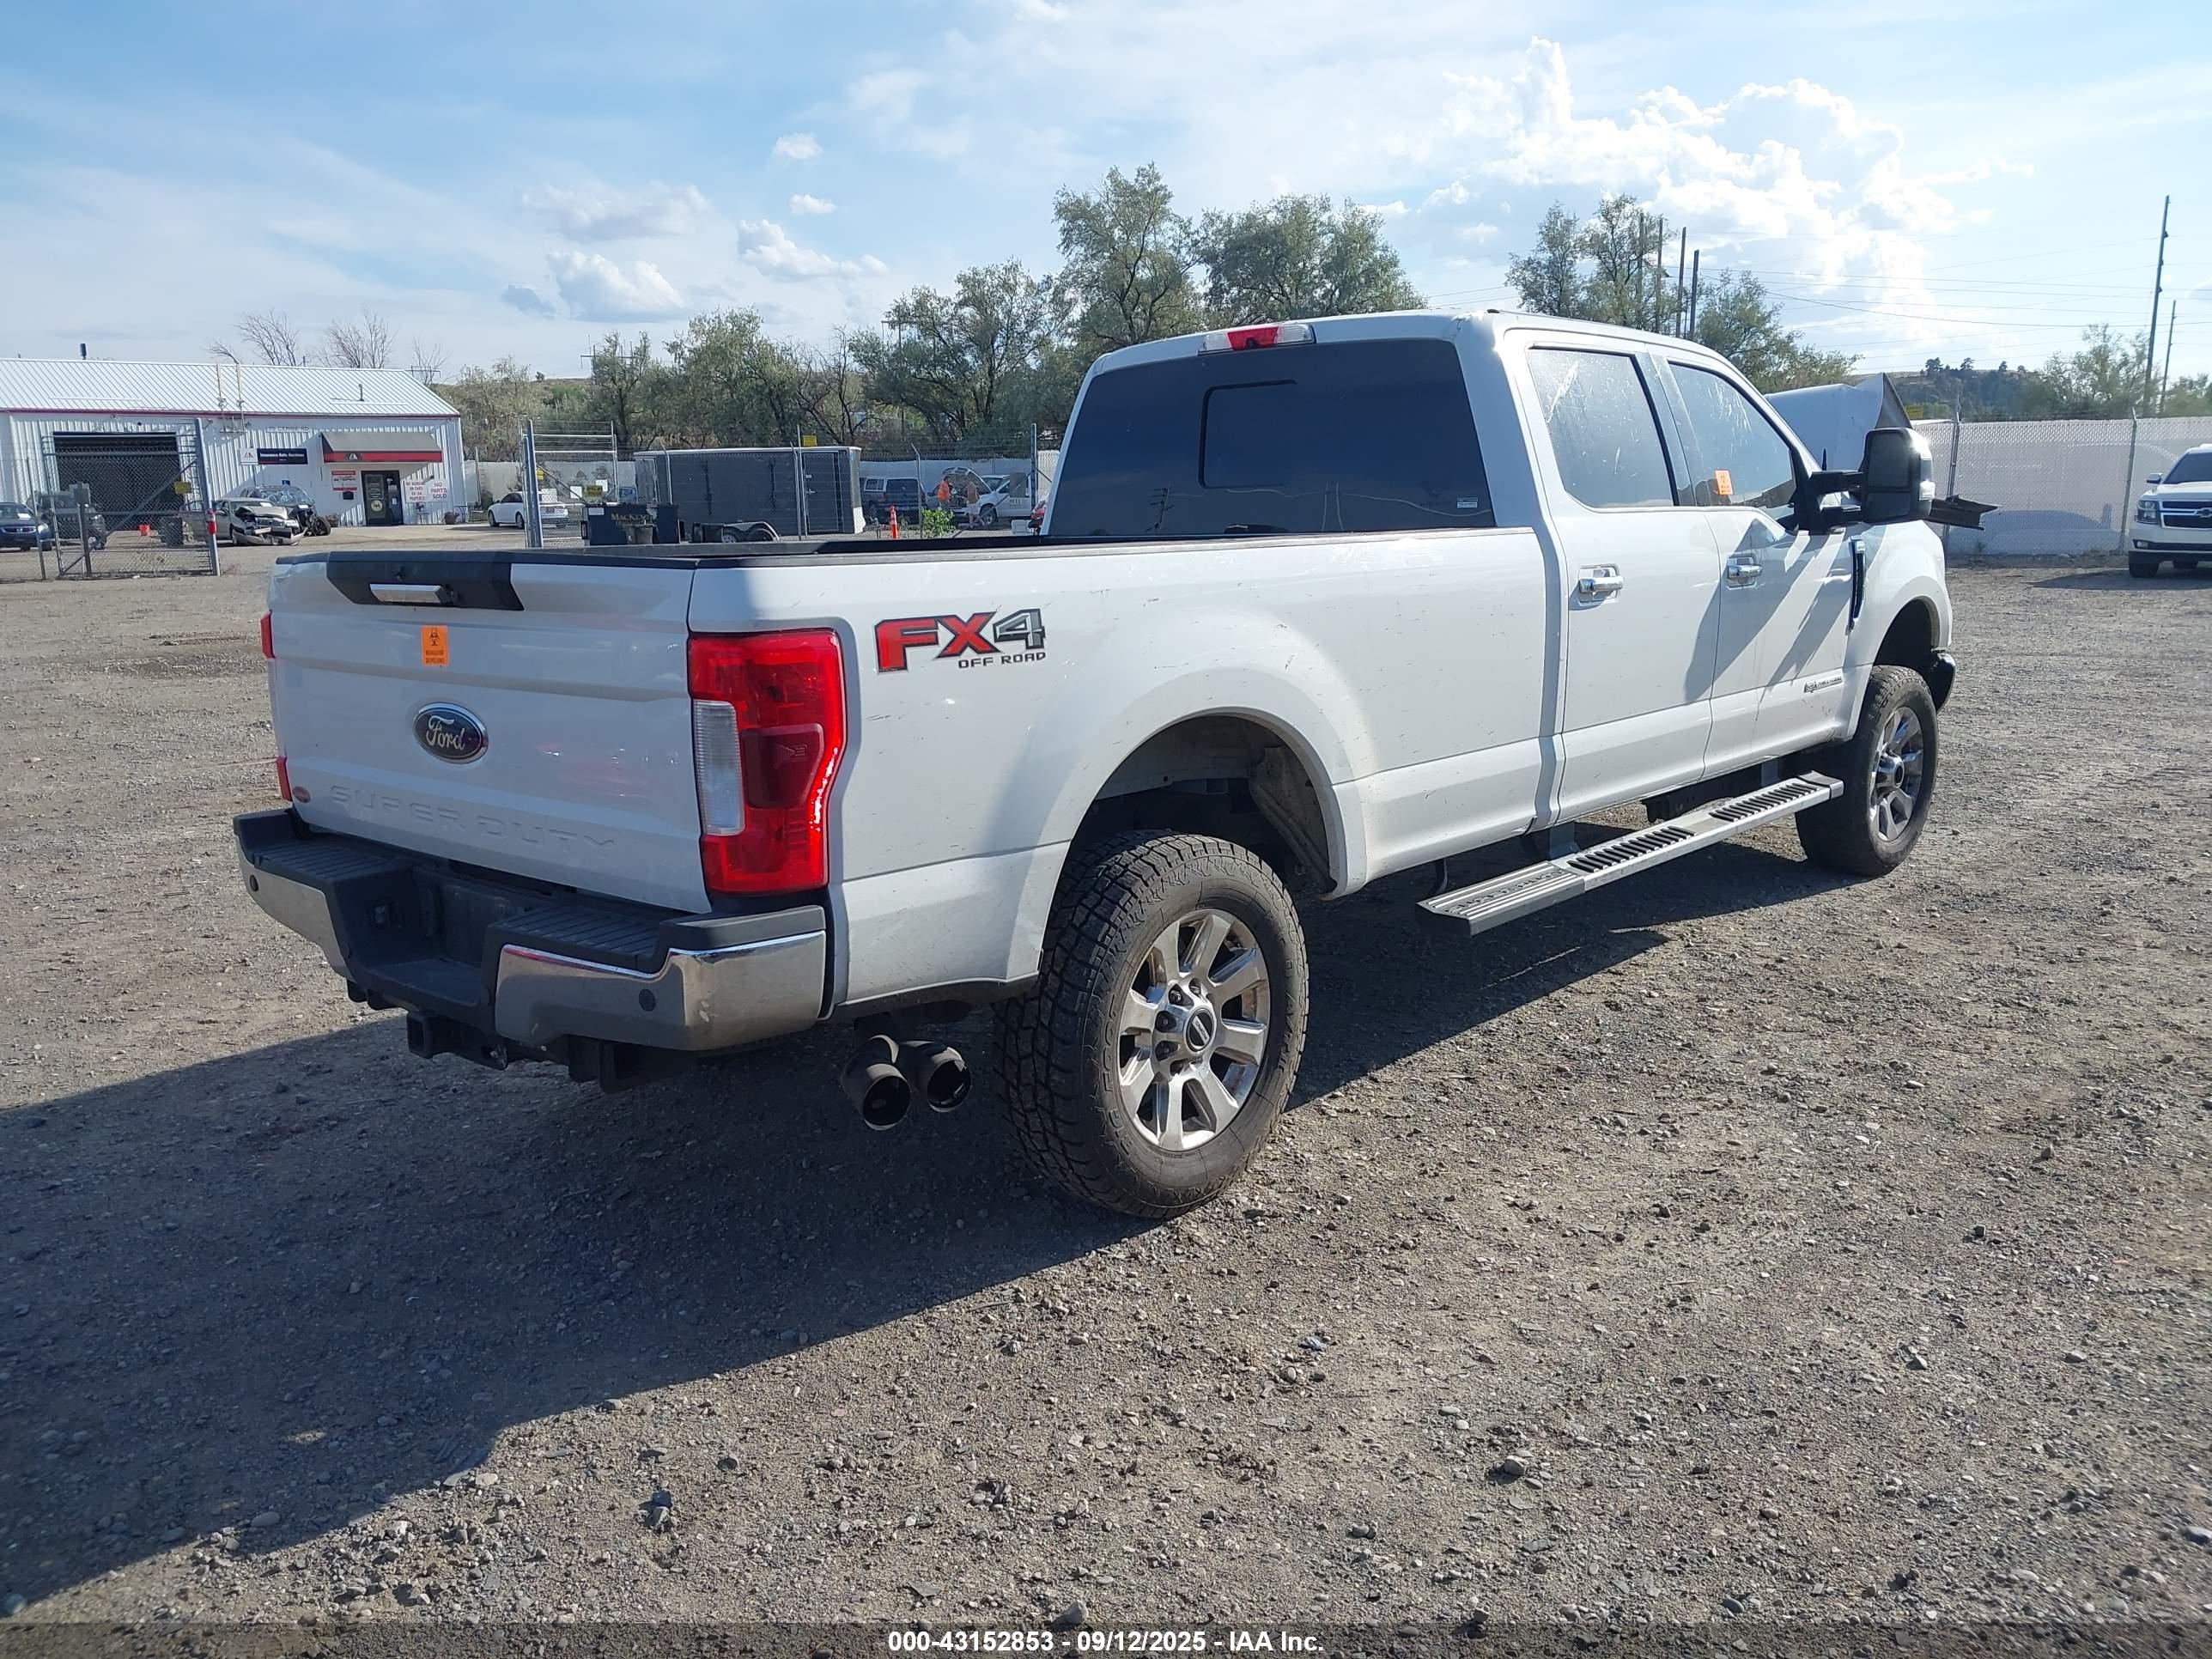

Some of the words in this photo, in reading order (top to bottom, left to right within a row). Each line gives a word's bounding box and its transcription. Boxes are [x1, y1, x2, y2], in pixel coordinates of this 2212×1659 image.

[874, 608, 1046, 672] FX4
[957, 657, 994, 669] OFF
[1001, 651, 1046, 665] ROAD
[426, 714, 465, 750] Ford
[330, 784, 466, 830] SUPER
[477, 815, 616, 857] DUTY
